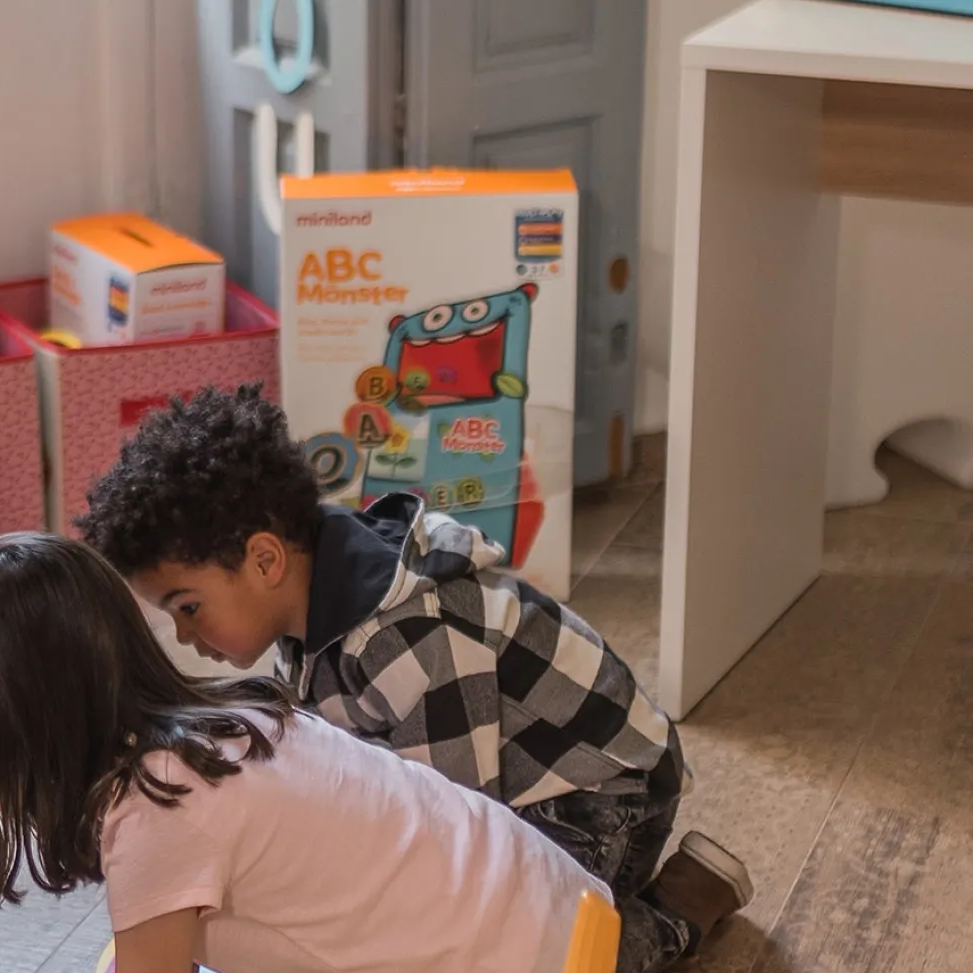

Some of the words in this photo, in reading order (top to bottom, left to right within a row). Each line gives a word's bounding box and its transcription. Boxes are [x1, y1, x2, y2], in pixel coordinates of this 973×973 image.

[296, 209, 373, 228] miniland
[298, 246, 384, 283] ABC
[296, 281, 410, 305] Monster
[368, 376, 385, 397] B
[357, 412, 384, 443] A
[451, 418, 501, 440] ABC
[441, 436, 507, 455] Monster
